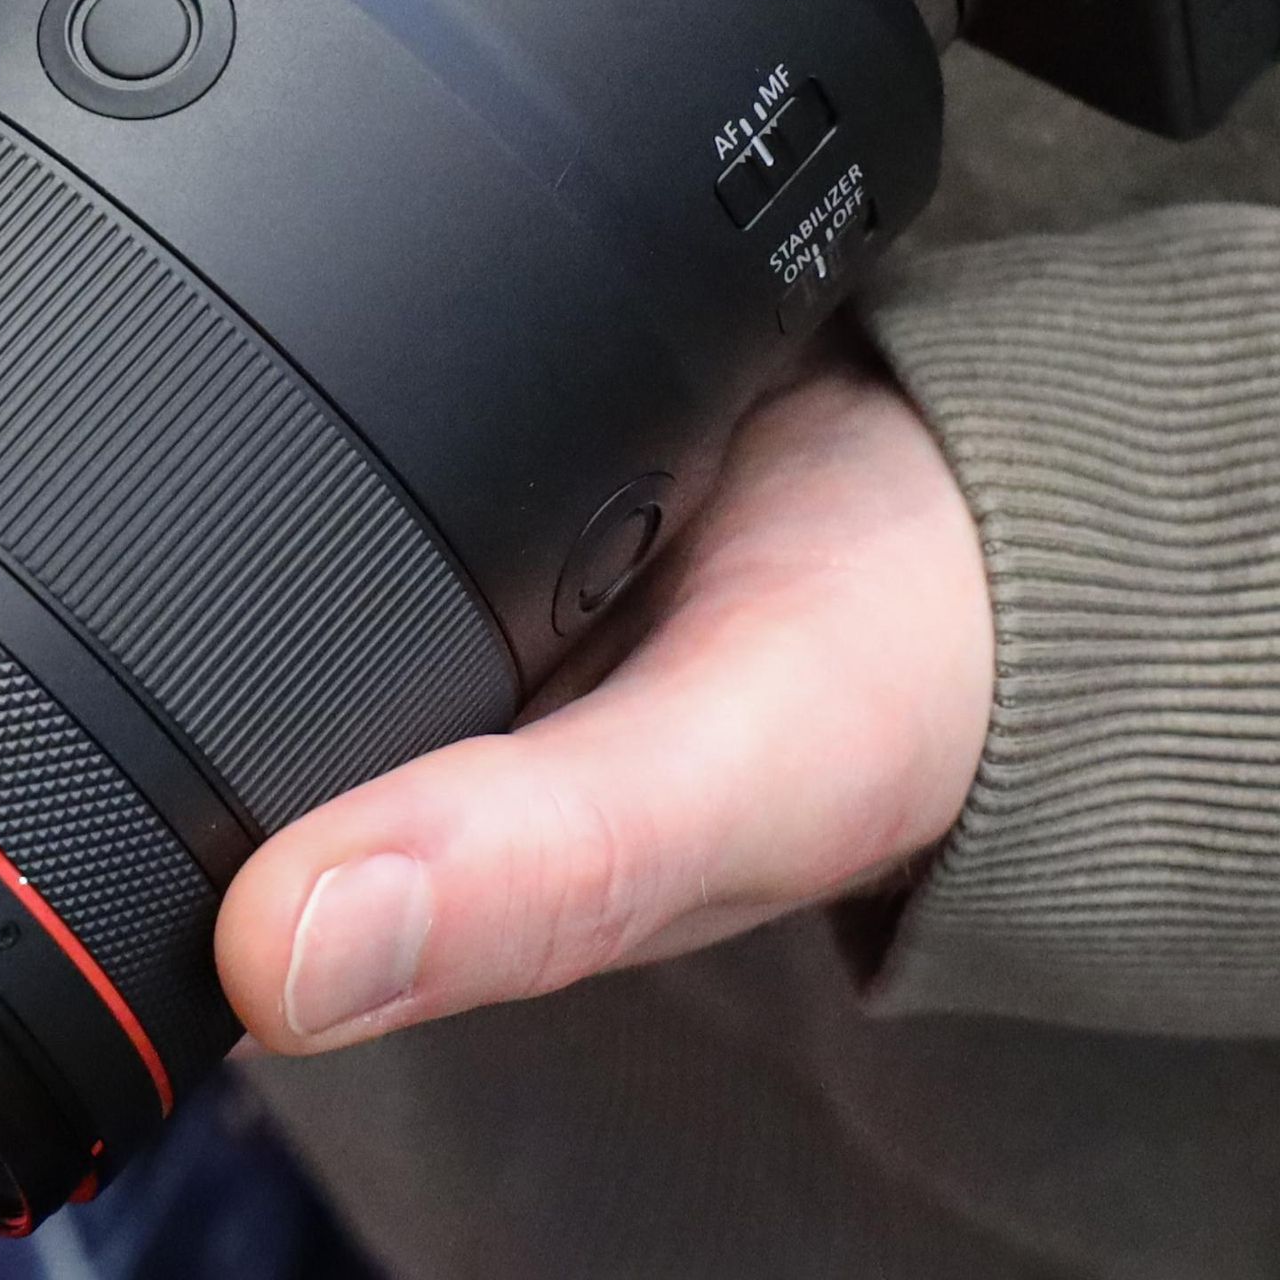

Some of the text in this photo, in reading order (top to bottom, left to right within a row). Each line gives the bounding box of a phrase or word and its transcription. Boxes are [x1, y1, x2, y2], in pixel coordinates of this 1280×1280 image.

[713, 63, 789, 160] AF MF
[769, 164, 864, 273] STABILIZER
[783, 187, 864, 284] ON OFF
